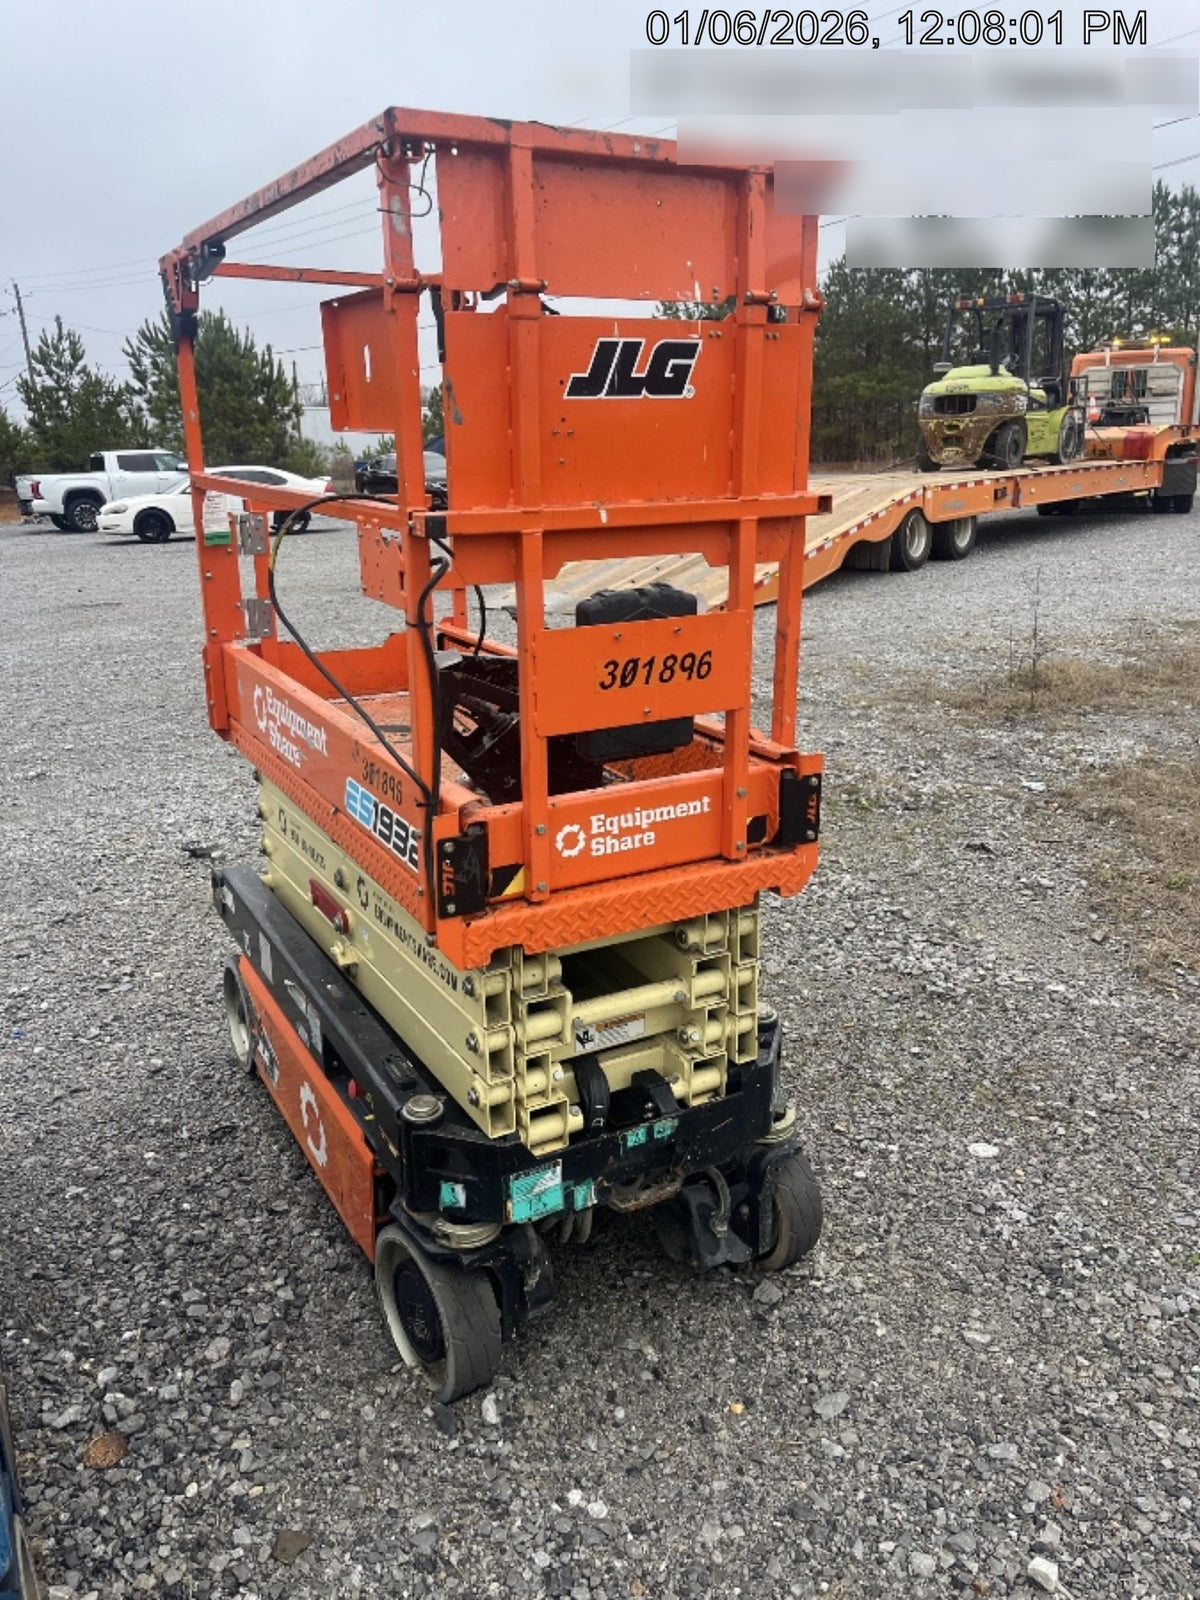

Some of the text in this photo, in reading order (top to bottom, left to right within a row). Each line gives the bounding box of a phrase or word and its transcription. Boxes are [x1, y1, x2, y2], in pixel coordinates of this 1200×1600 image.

[564, 338, 702, 399] JLG
[599, 650, 712, 690] 301896
[265, 686, 328, 756] Equipment
[268, 720, 302, 768] Share
[362, 758, 403, 806] 301896
[590, 796, 712, 834] Equipment
[590, 831, 656, 856] Share
[442, 860, 455, 896] JLG
